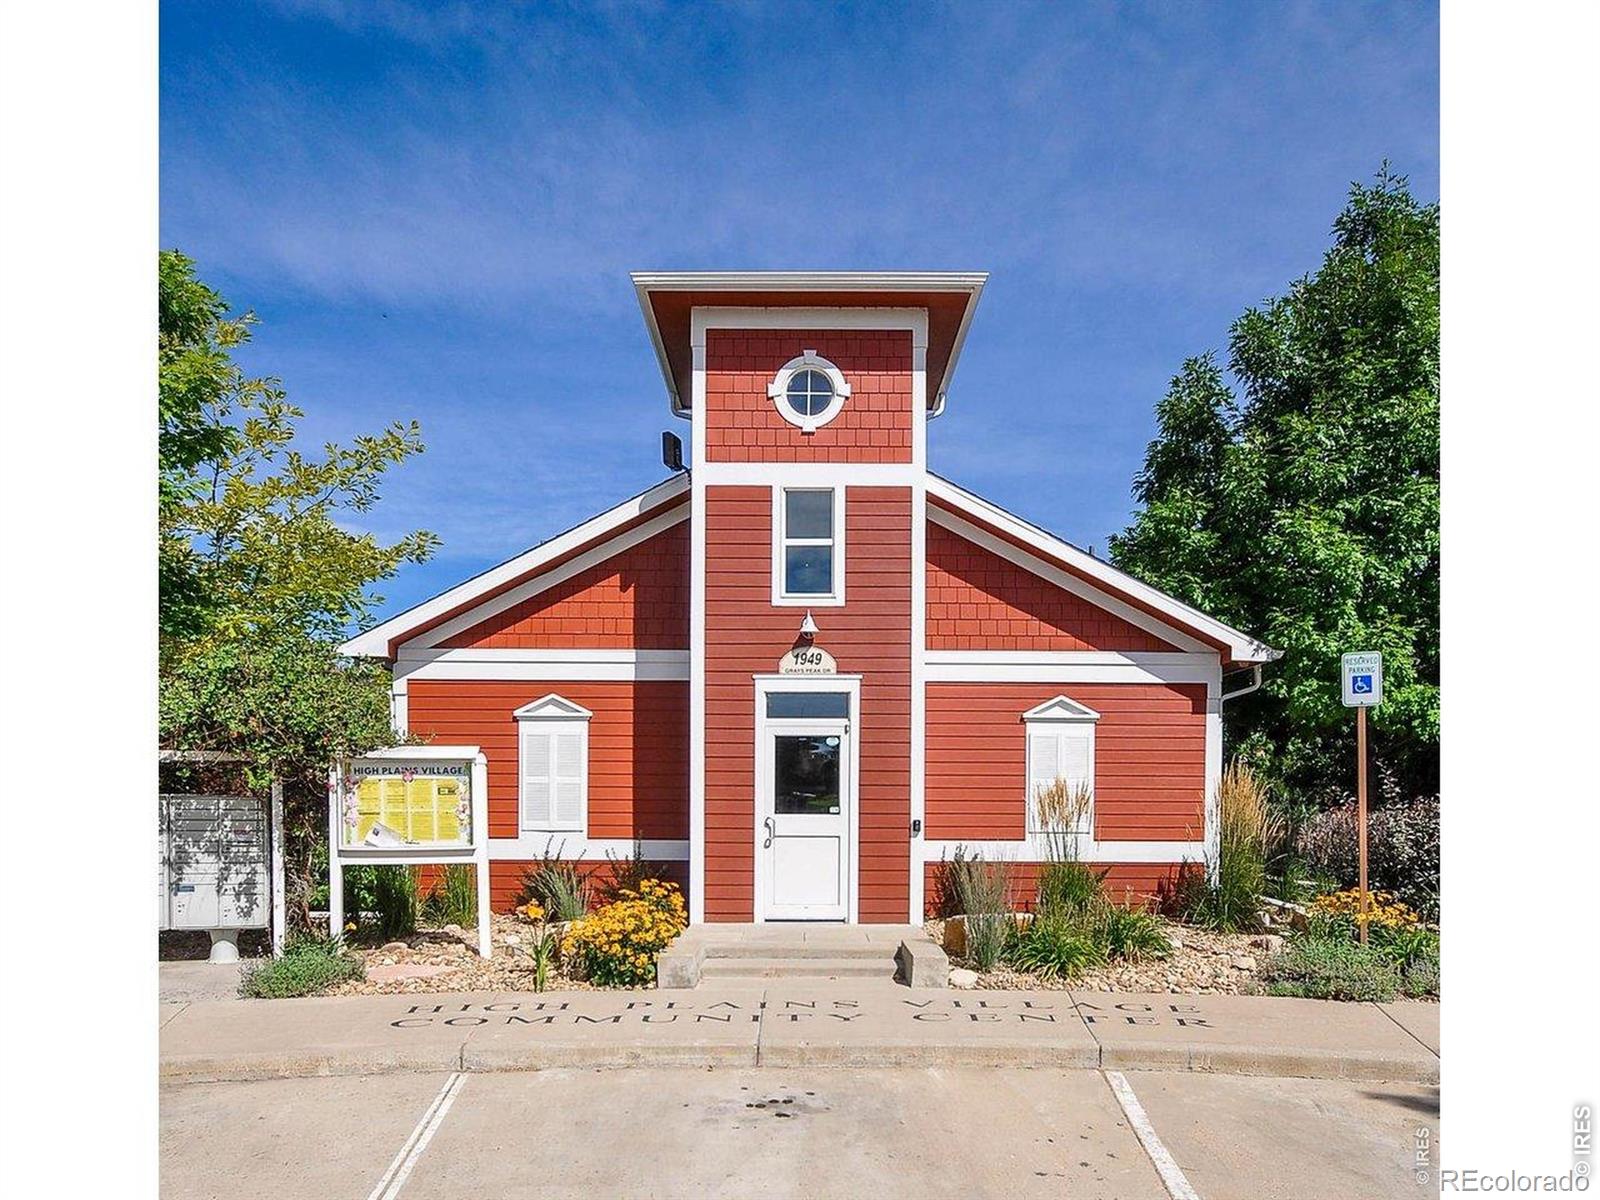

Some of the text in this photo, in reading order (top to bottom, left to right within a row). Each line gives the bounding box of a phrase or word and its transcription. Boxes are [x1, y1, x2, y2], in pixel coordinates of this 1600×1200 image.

[794, 652, 823, 666] 1949
[353, 766, 465, 776] HIGH PLAINS VILLAGE
[407, 1000, 1202, 1014] HIGH PLAINS VILLAGE
[390, 1012, 1216, 1028] COMMUNITY CENTER
